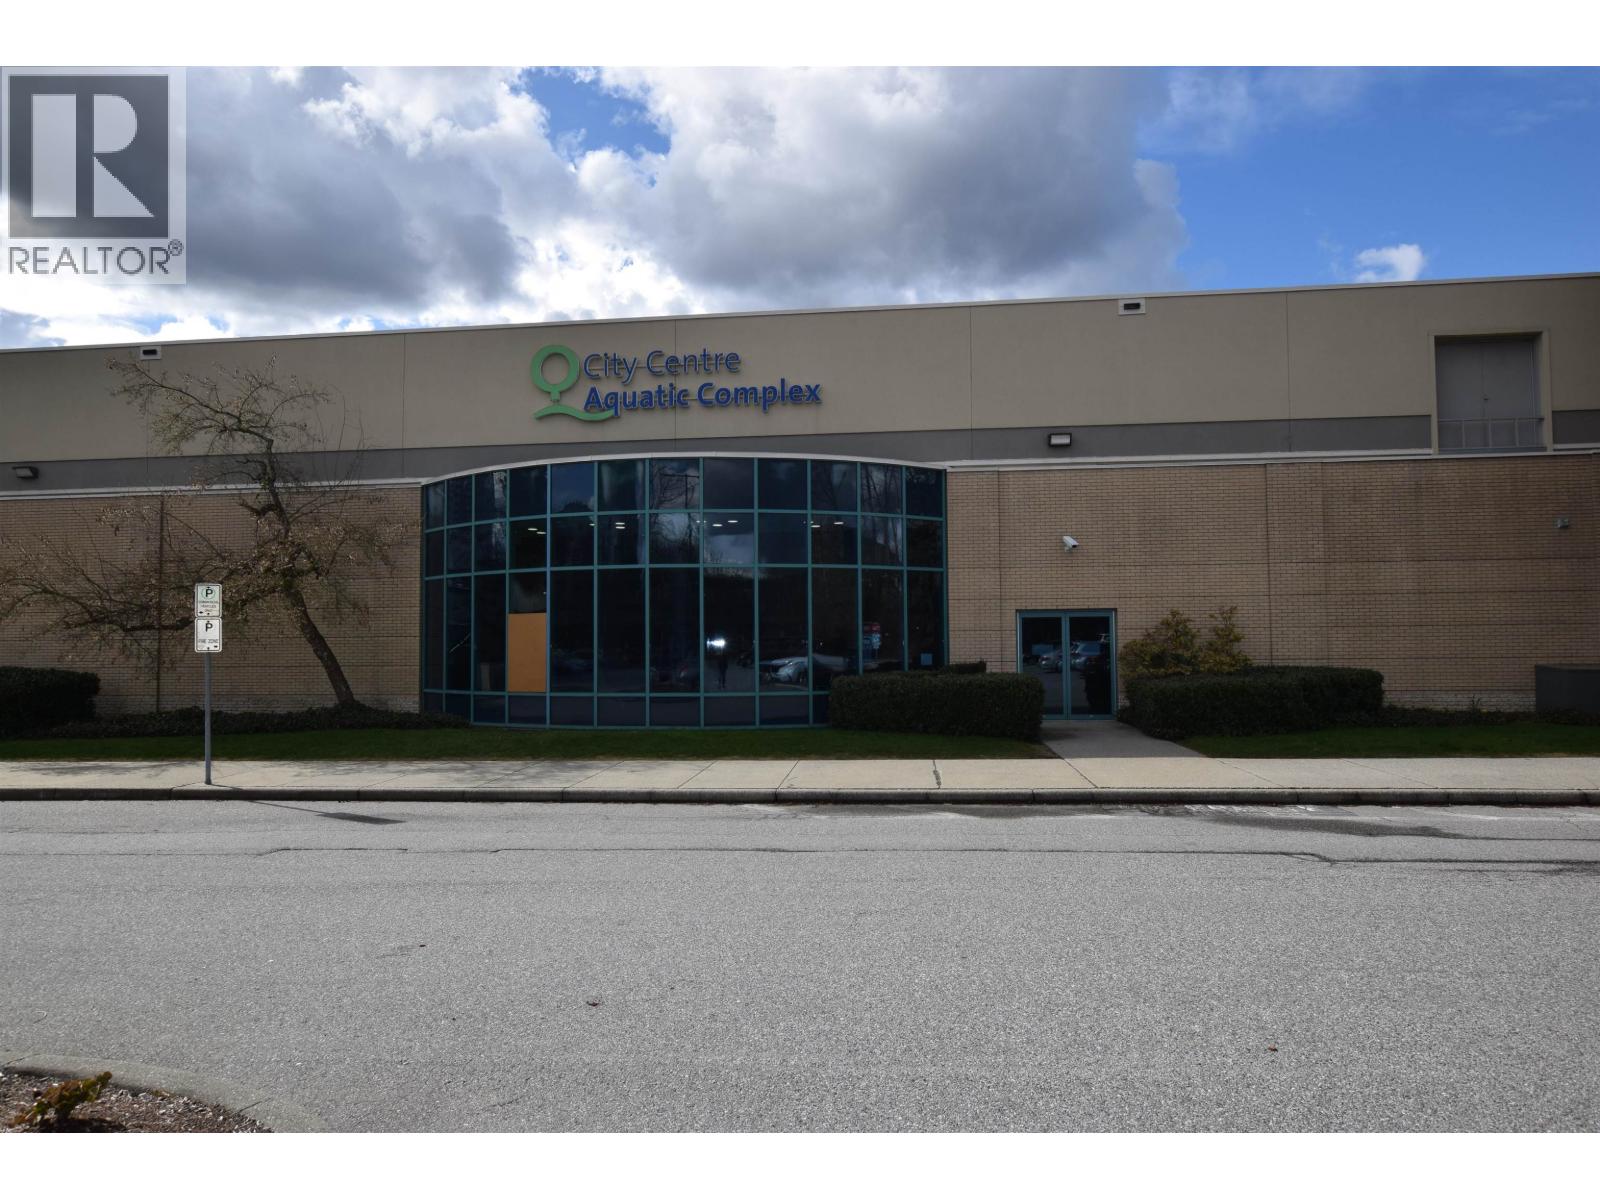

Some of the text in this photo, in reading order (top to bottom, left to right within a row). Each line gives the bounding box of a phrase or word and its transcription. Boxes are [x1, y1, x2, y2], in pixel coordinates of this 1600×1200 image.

[583, 348, 741, 384] City Centre
[583, 377, 822, 416] Aquatic Complex
[205, 588, 214, 598] P
[205, 622, 214, 632] P
